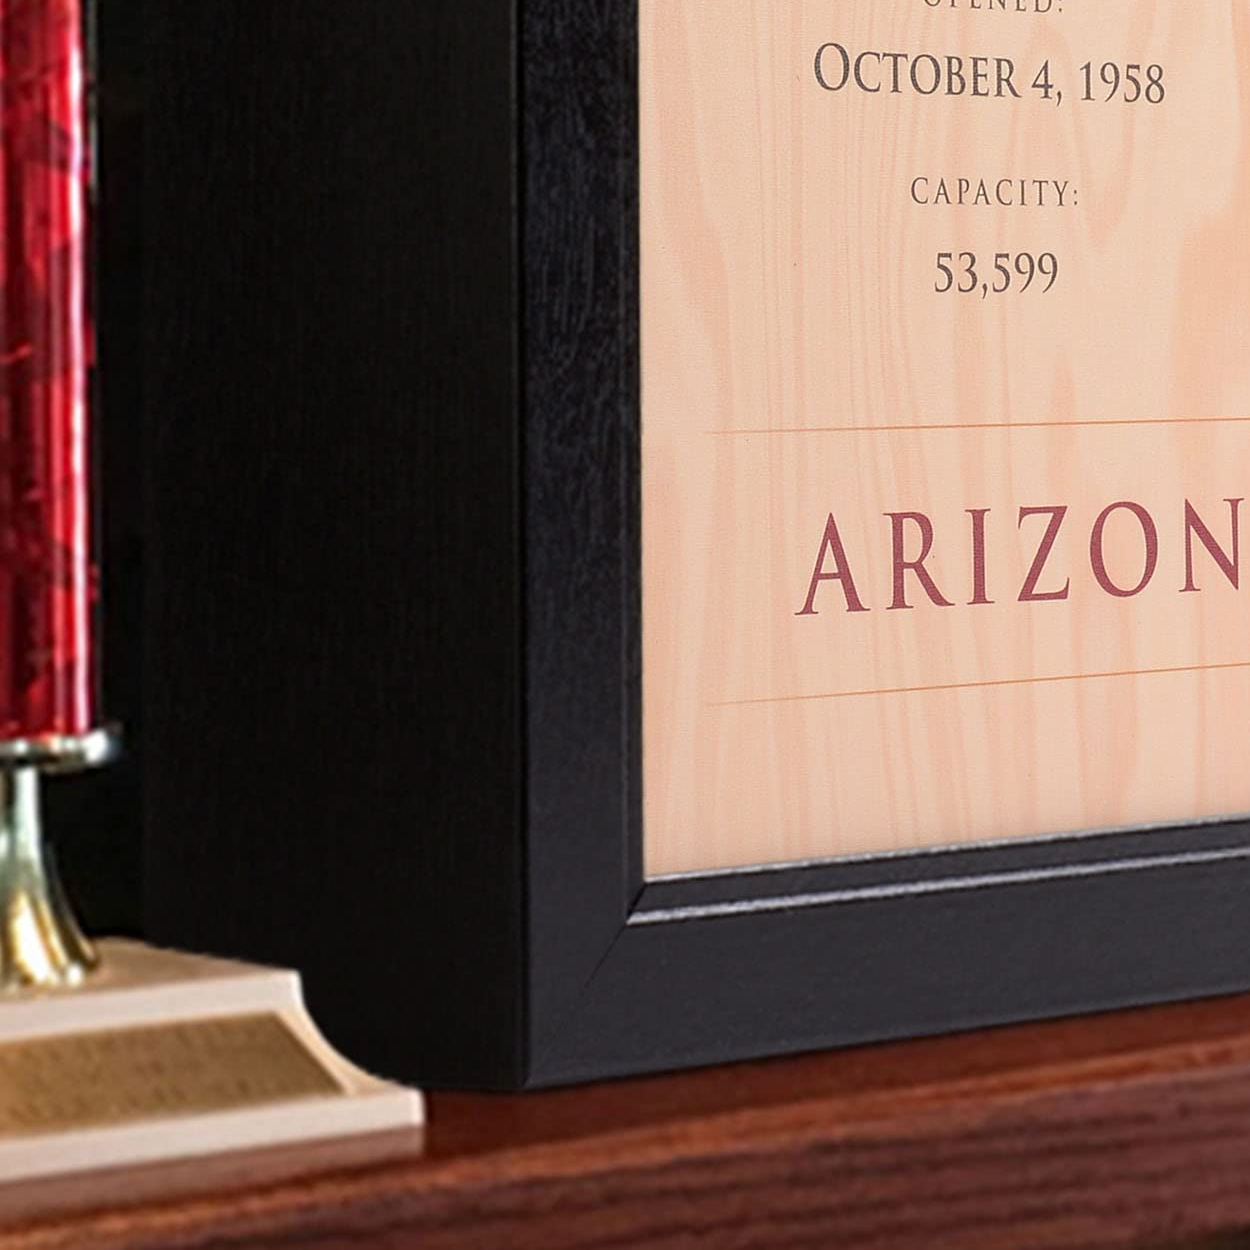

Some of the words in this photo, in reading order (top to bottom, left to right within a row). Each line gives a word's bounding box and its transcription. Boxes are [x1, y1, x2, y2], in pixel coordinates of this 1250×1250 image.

[813, 42, 1022, 99] OCTOBER
[1031, 60, 1063, 107] 4,
[1080, 61, 1166, 104] 1958
[910, 176, 1079, 207] CAPACITY:
[934, 251, 1059, 300] 53,599
